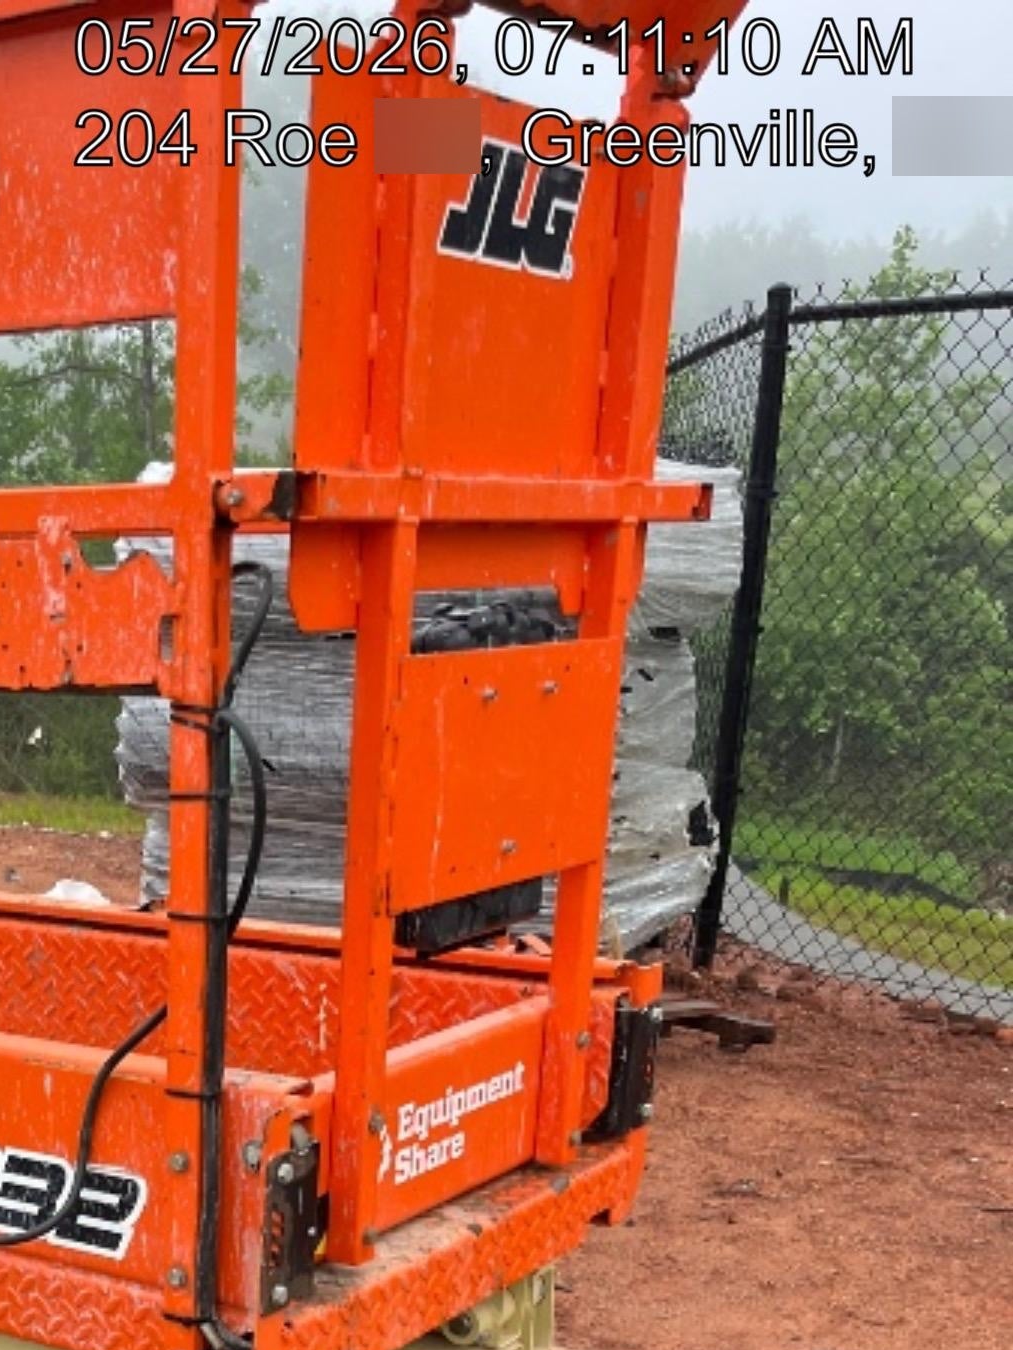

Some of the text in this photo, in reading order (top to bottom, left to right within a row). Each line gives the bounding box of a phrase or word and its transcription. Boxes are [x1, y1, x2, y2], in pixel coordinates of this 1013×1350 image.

[438, 137, 586, 277] JLG
[396, 1060, 526, 1142] Equipment
[393, 1131, 466, 1186] Share
